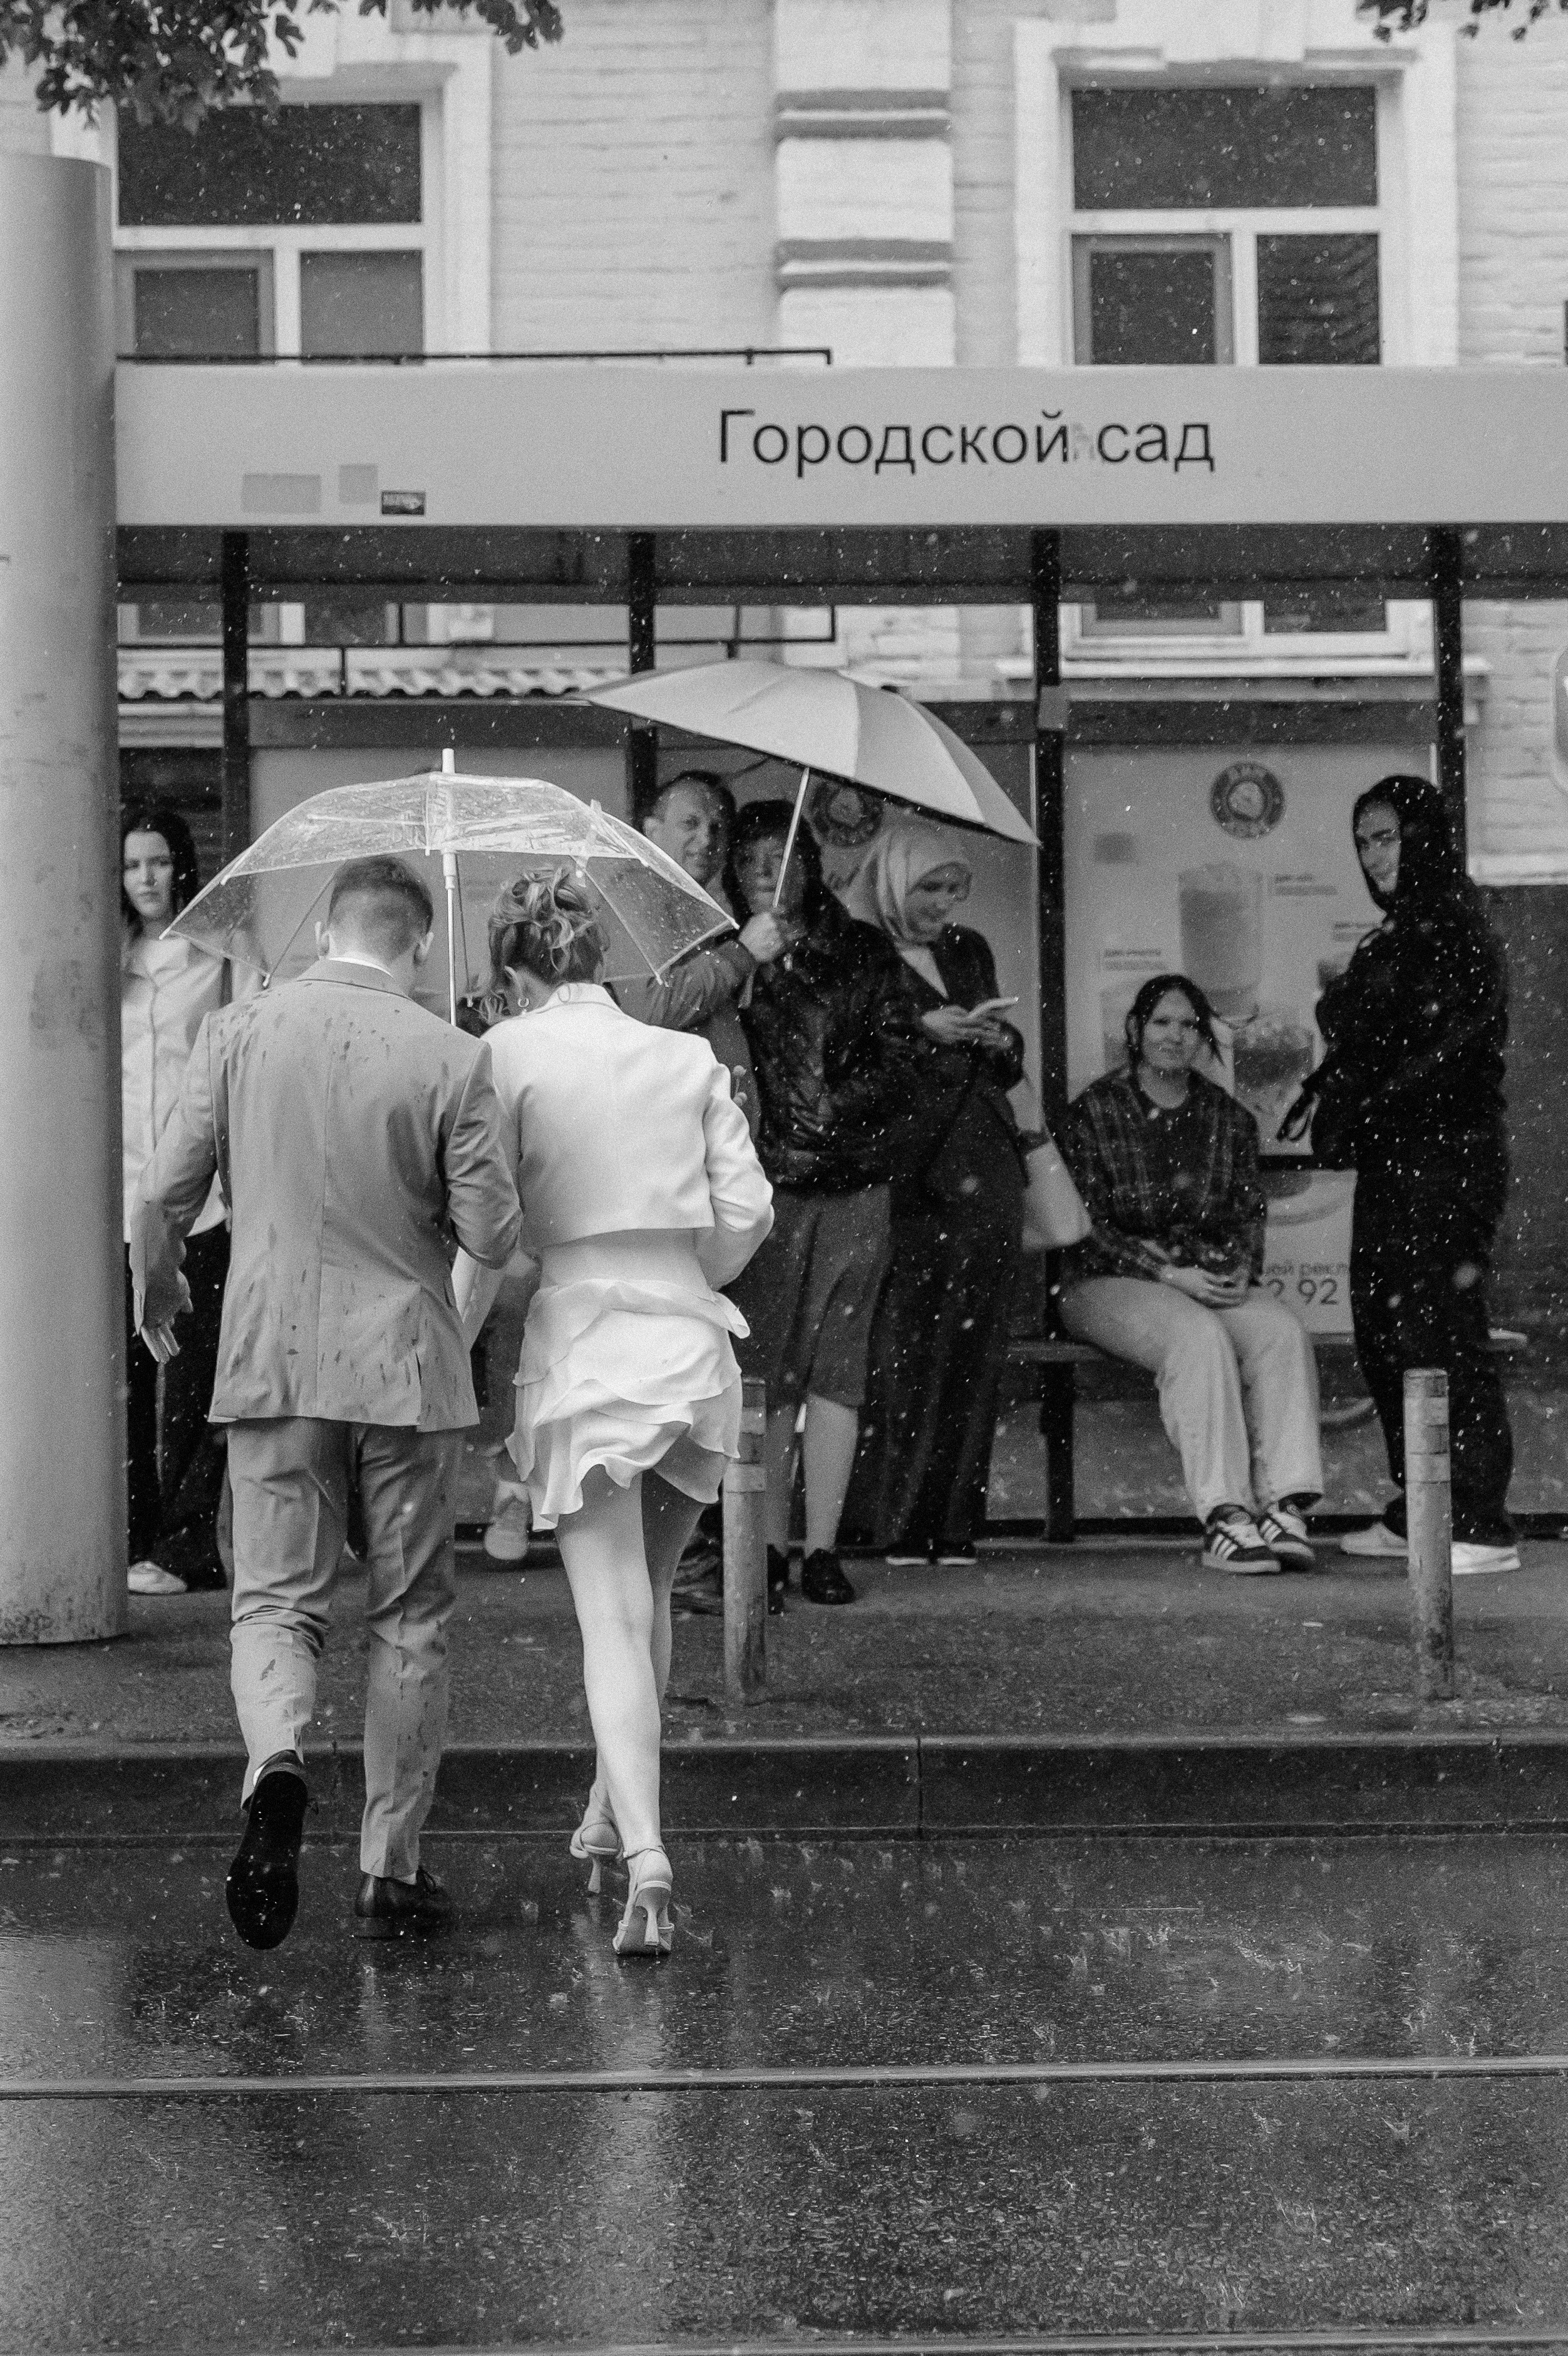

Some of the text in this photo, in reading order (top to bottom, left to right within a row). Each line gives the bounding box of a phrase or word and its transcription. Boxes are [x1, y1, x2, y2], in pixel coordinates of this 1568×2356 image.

[720, 409, 1215, 478] Городской сад
[1297, 1278, 1339, 1306] 92
